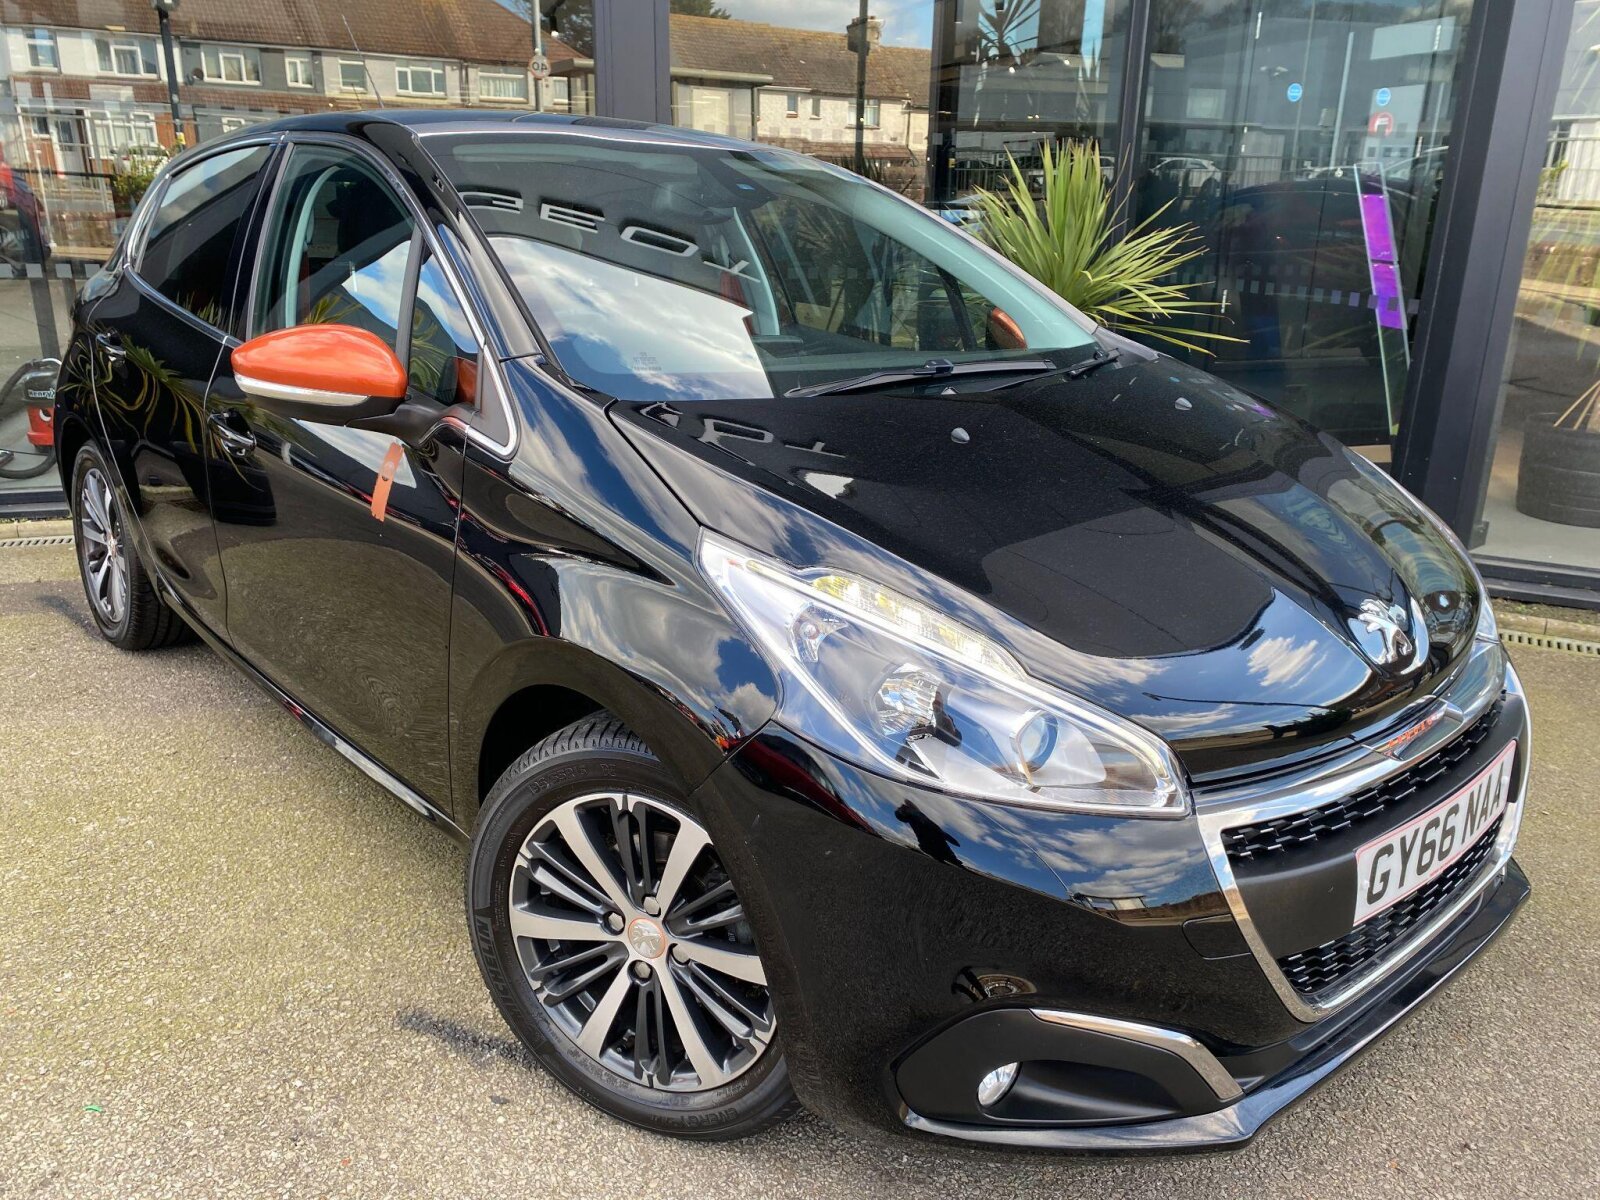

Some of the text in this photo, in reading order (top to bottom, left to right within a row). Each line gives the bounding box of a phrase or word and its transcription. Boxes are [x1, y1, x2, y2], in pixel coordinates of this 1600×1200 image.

[1367, 761, 1504, 905] GY66 NAA
[476, 918, 523, 1019] MICHELIN
